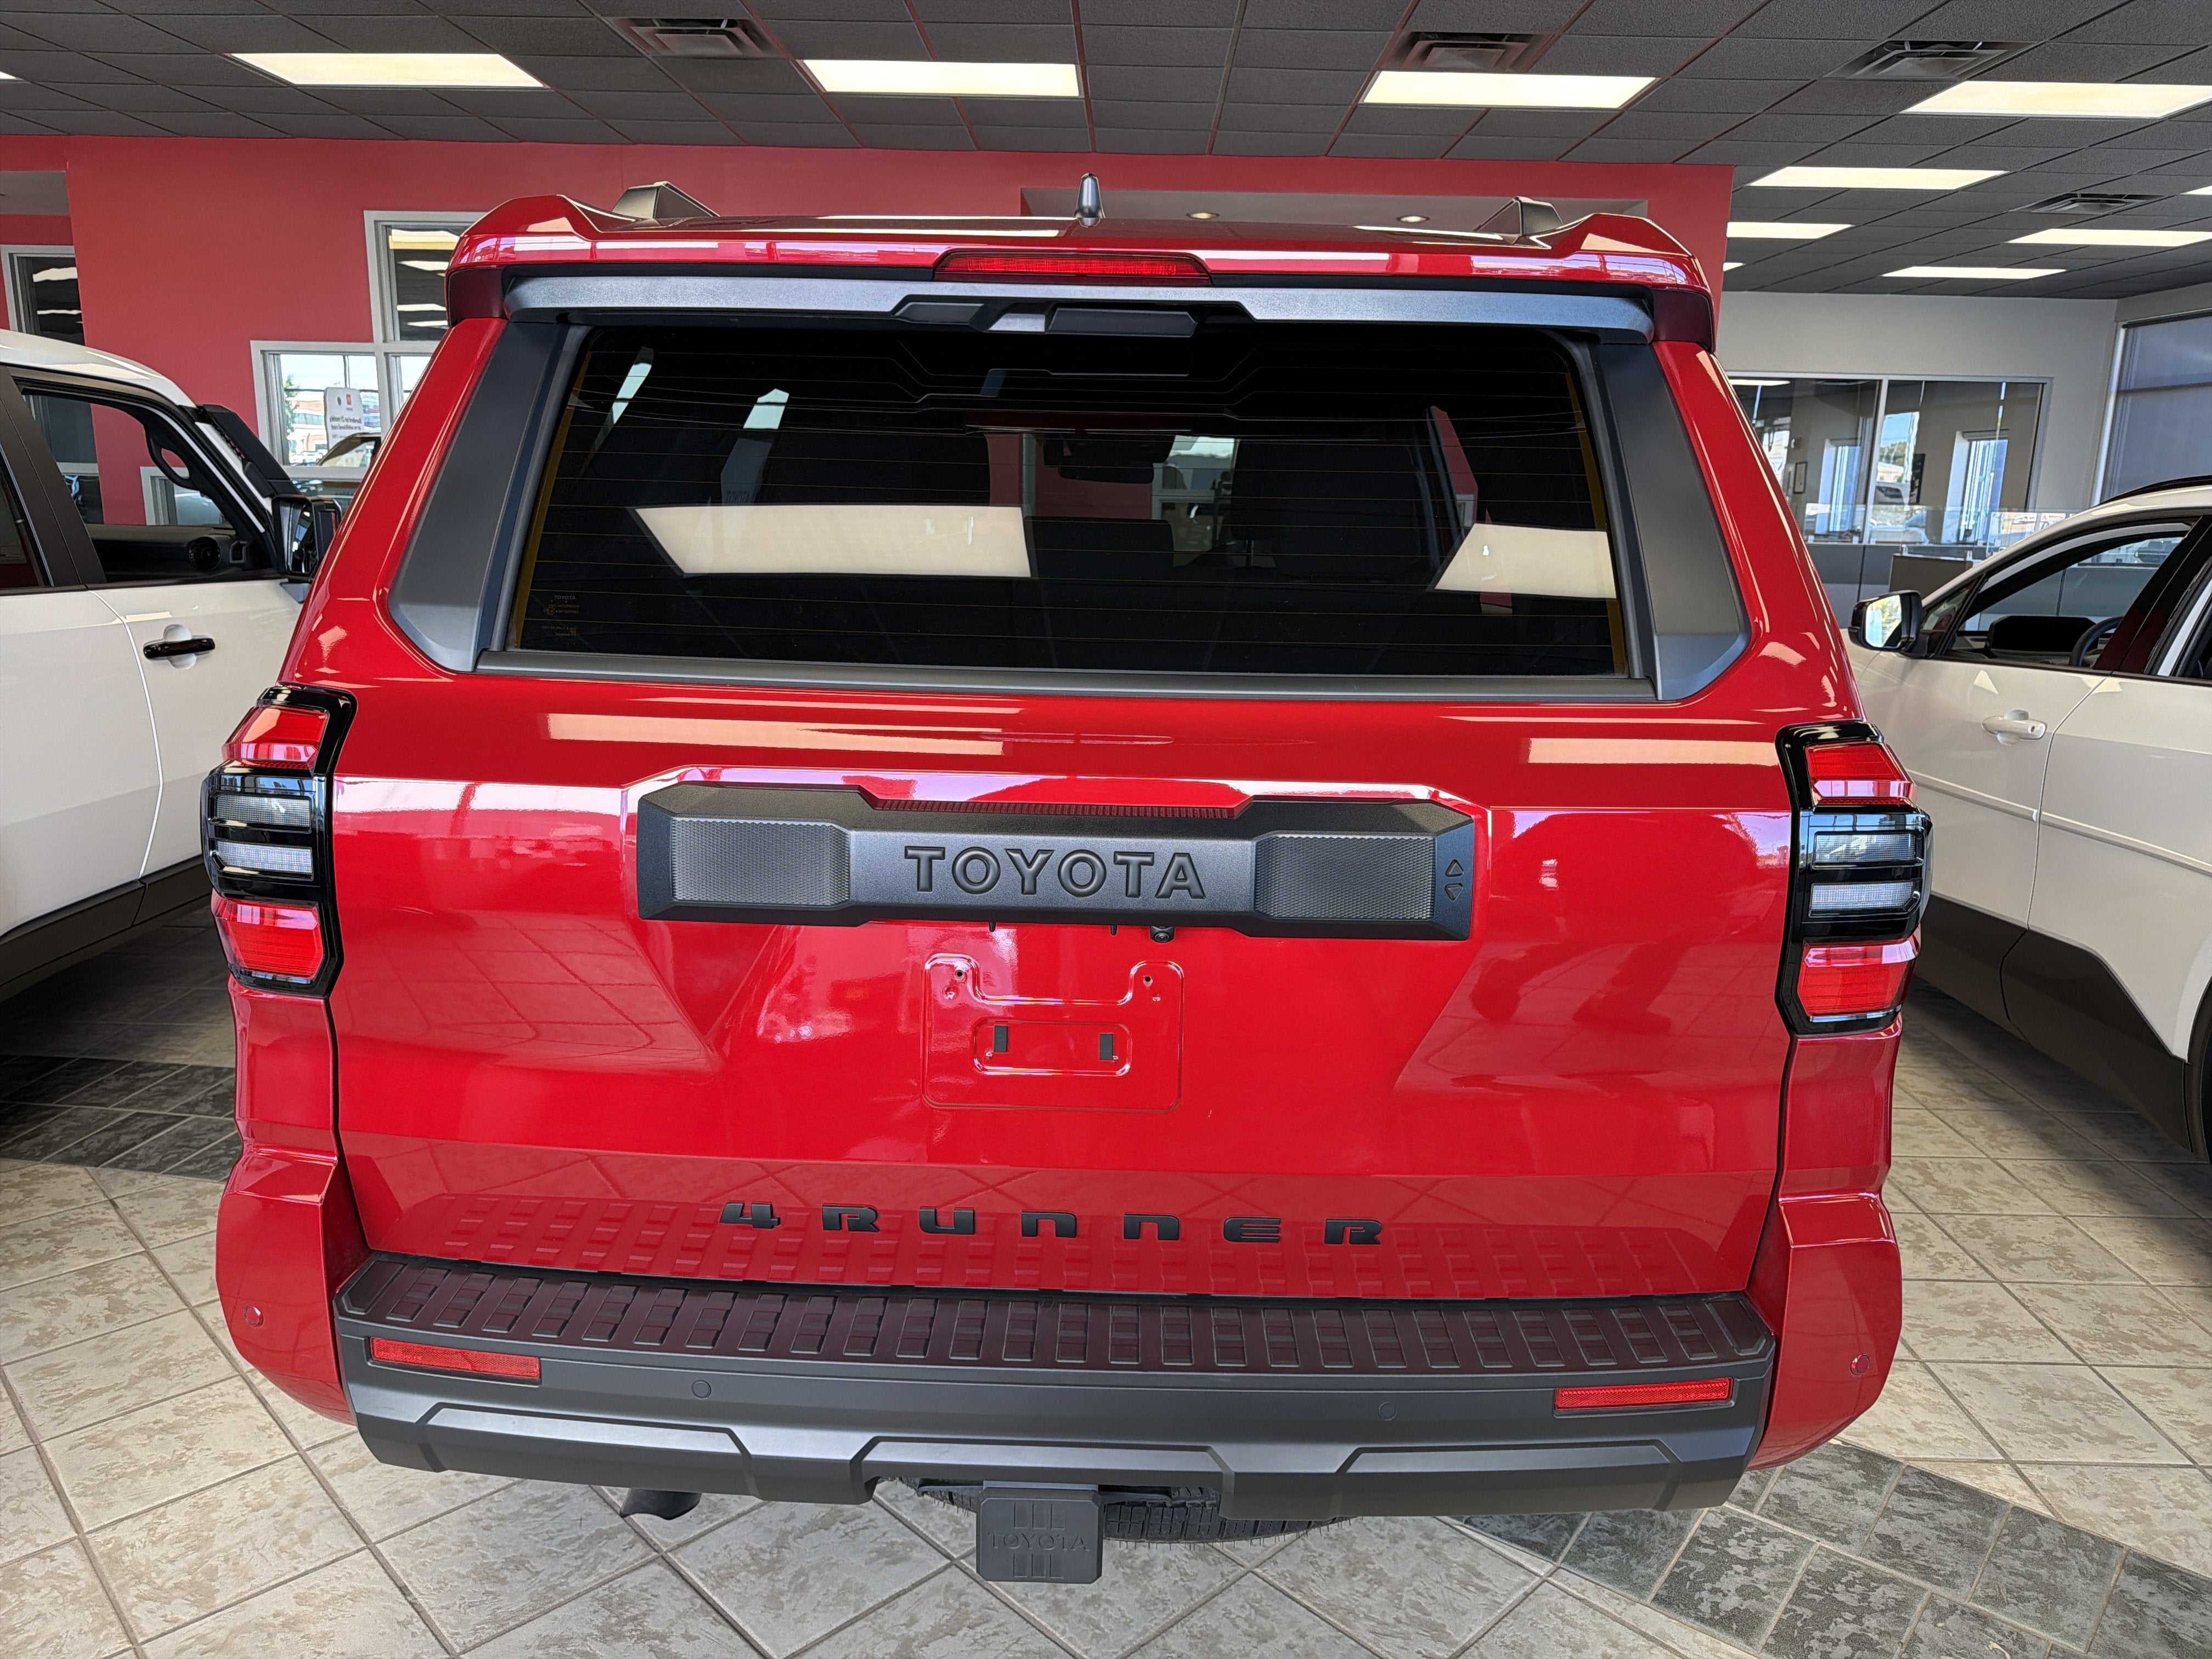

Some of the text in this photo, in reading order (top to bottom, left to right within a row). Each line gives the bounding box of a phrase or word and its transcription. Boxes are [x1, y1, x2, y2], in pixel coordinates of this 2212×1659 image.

[904, 845, 1206, 900] TOYOTA
[719, 1201, 1383, 1245] 4RUNNER
[988, 1532, 1090, 1551] TOYOTA
